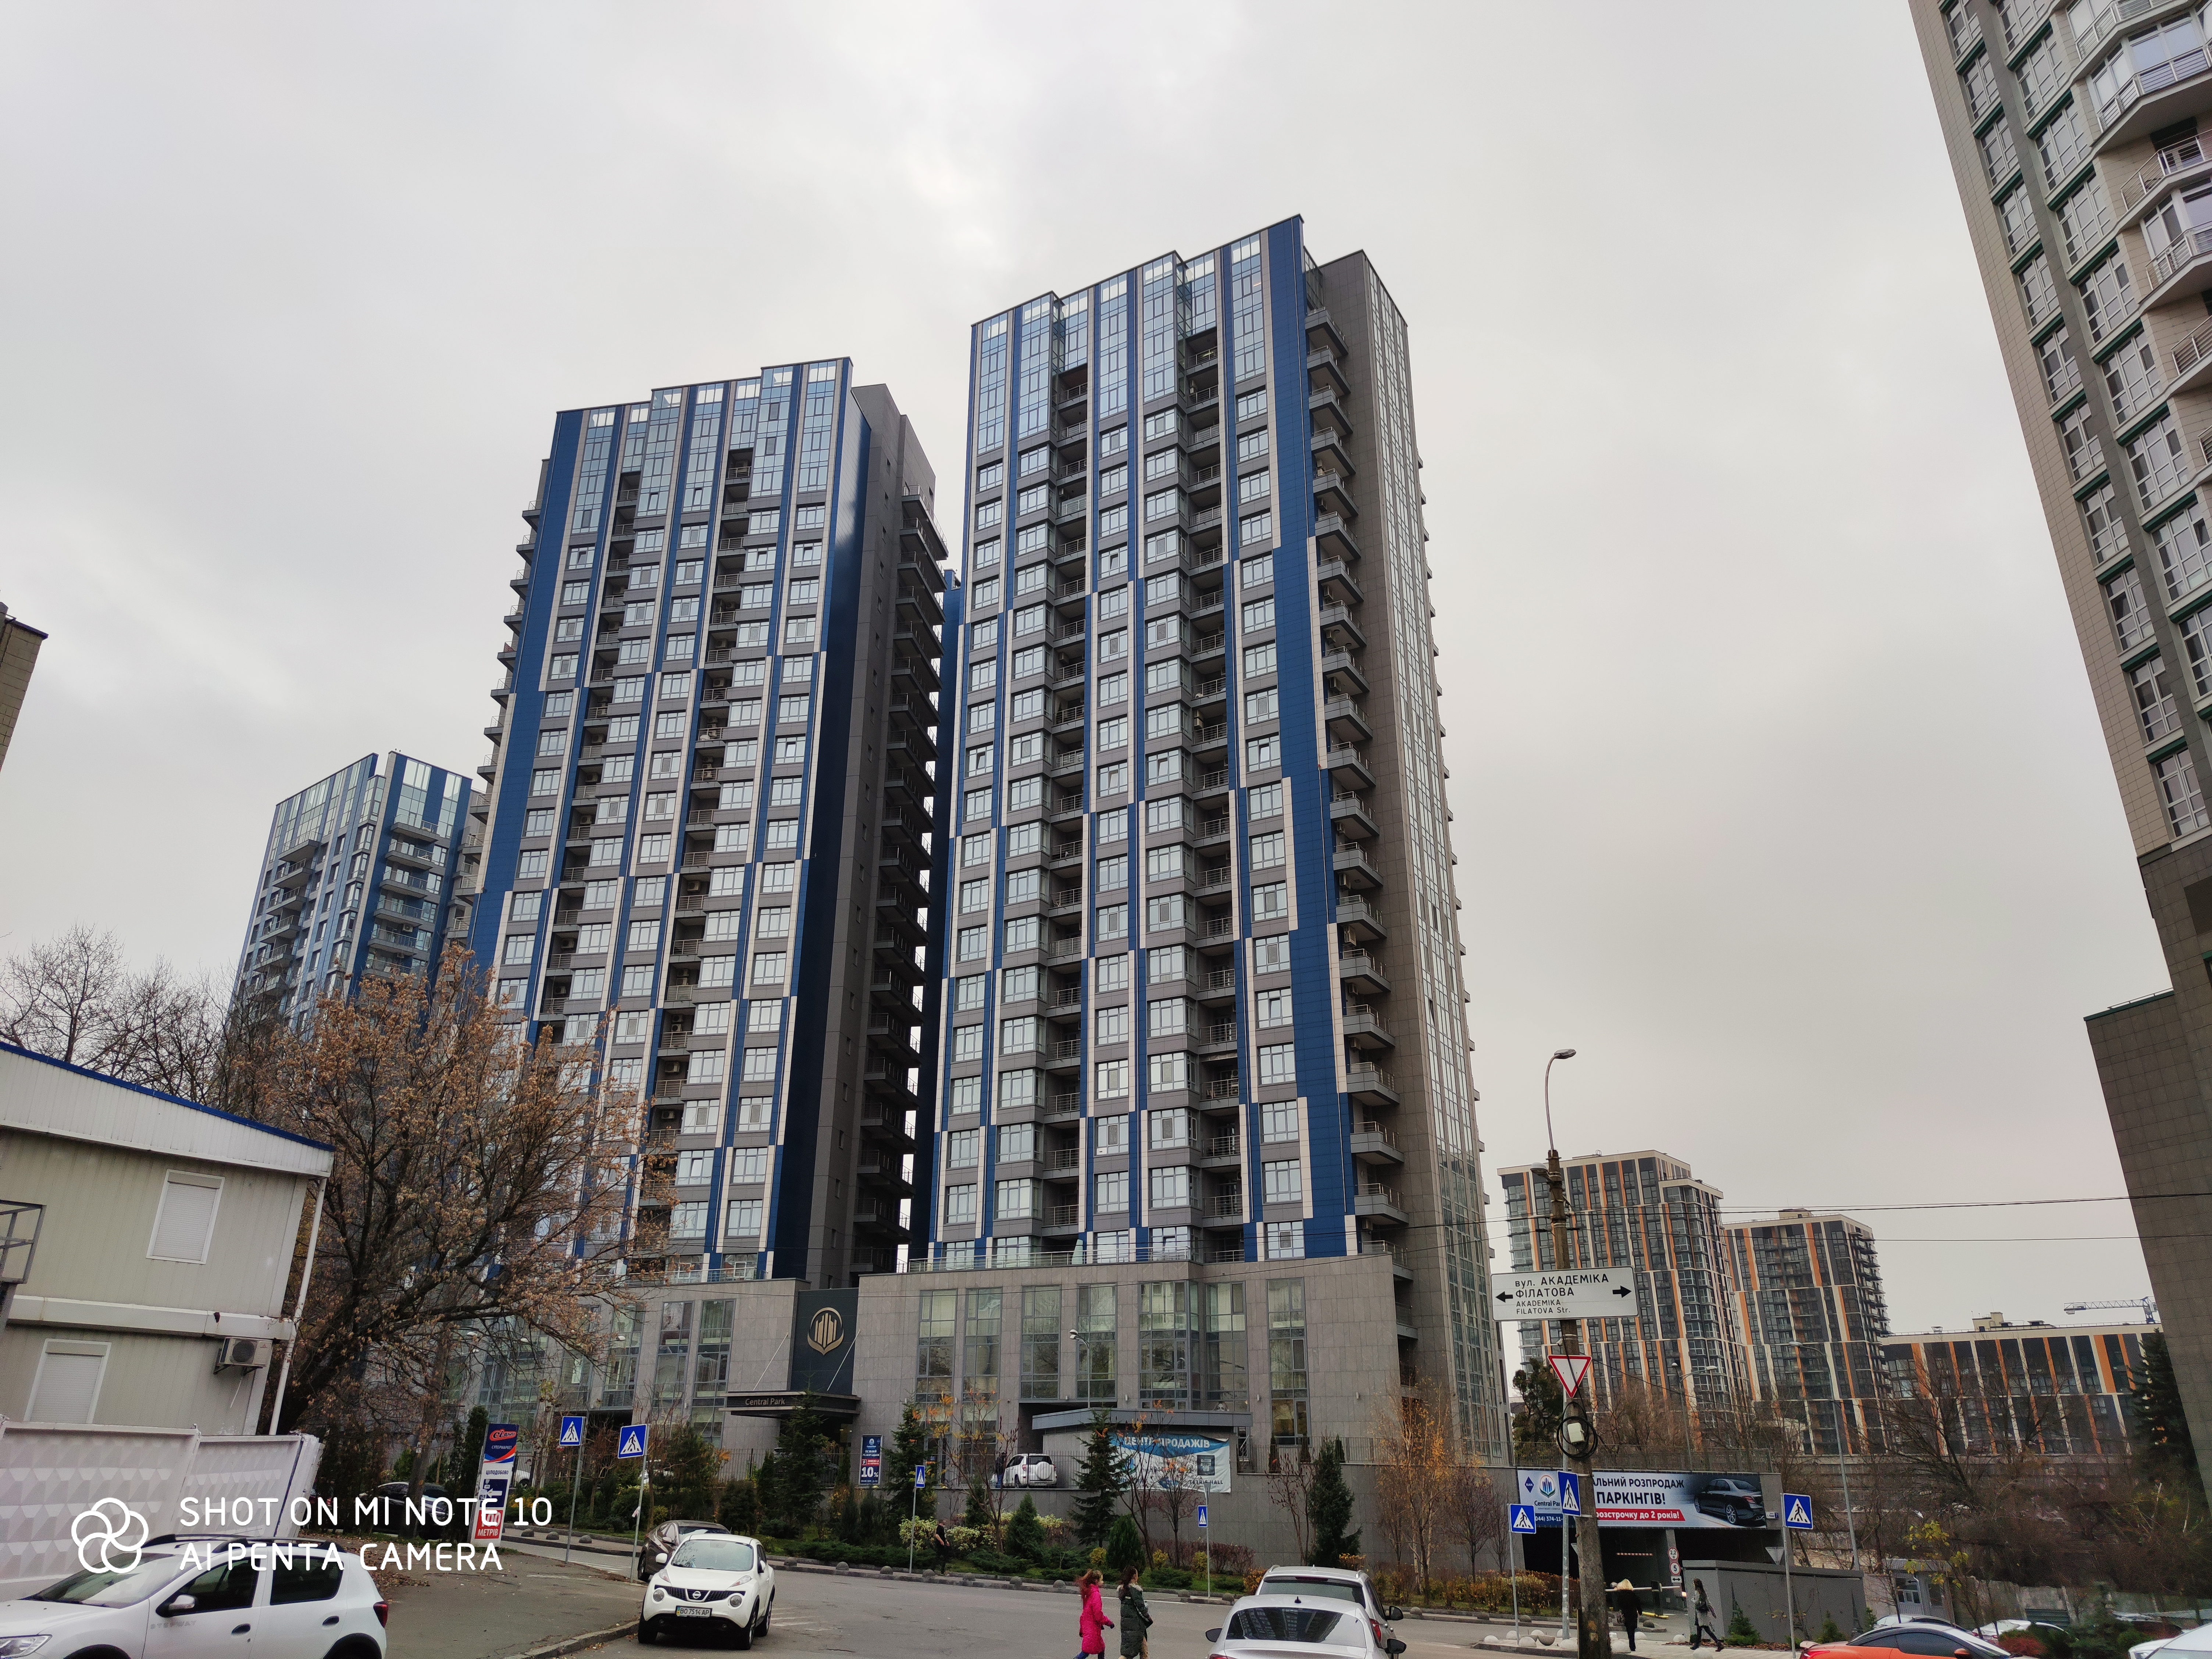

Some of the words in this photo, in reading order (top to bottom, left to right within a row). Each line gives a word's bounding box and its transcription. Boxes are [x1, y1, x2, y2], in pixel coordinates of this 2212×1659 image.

[1515, 1280, 1535, 1289] вул.
[1541, 1274, 1609, 1286] АКАДЕМІКА
[1515, 1287, 1574, 1298] ФІЛАТОВА
[1629, 1479, 1684, 1489] РОЗПРОДАЖ
[1596, 1491, 1666, 1505] ПАРКІНГІВ!
[481, 1512, 501, 1527] 00
[1657, 1511, 1680, 1520] років!
